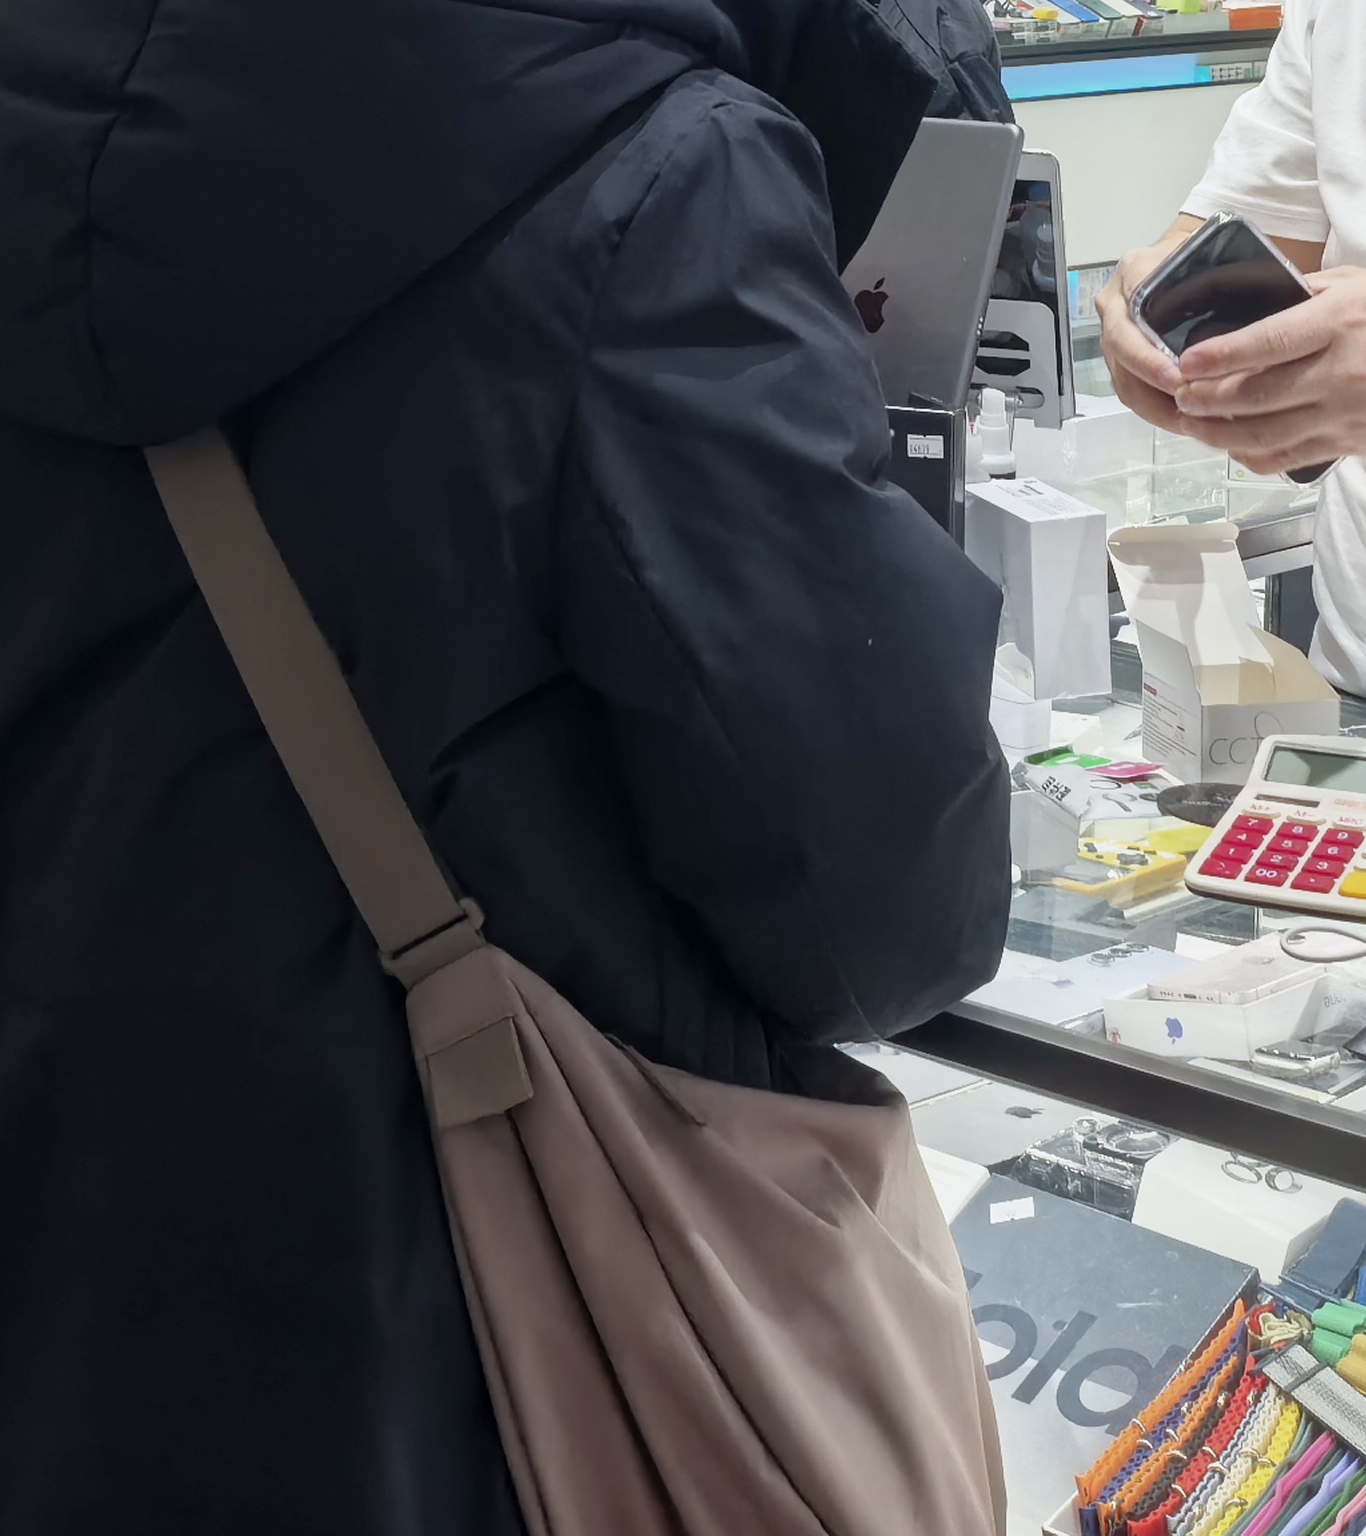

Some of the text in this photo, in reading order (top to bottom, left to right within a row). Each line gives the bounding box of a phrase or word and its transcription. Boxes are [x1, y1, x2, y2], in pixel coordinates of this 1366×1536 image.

[1337, 831, 1349, 840] 9
[1328, 846, 1339, 855] 6
[1317, 861, 1328, 870] 3
[1255, 868, 1277, 878] 00
